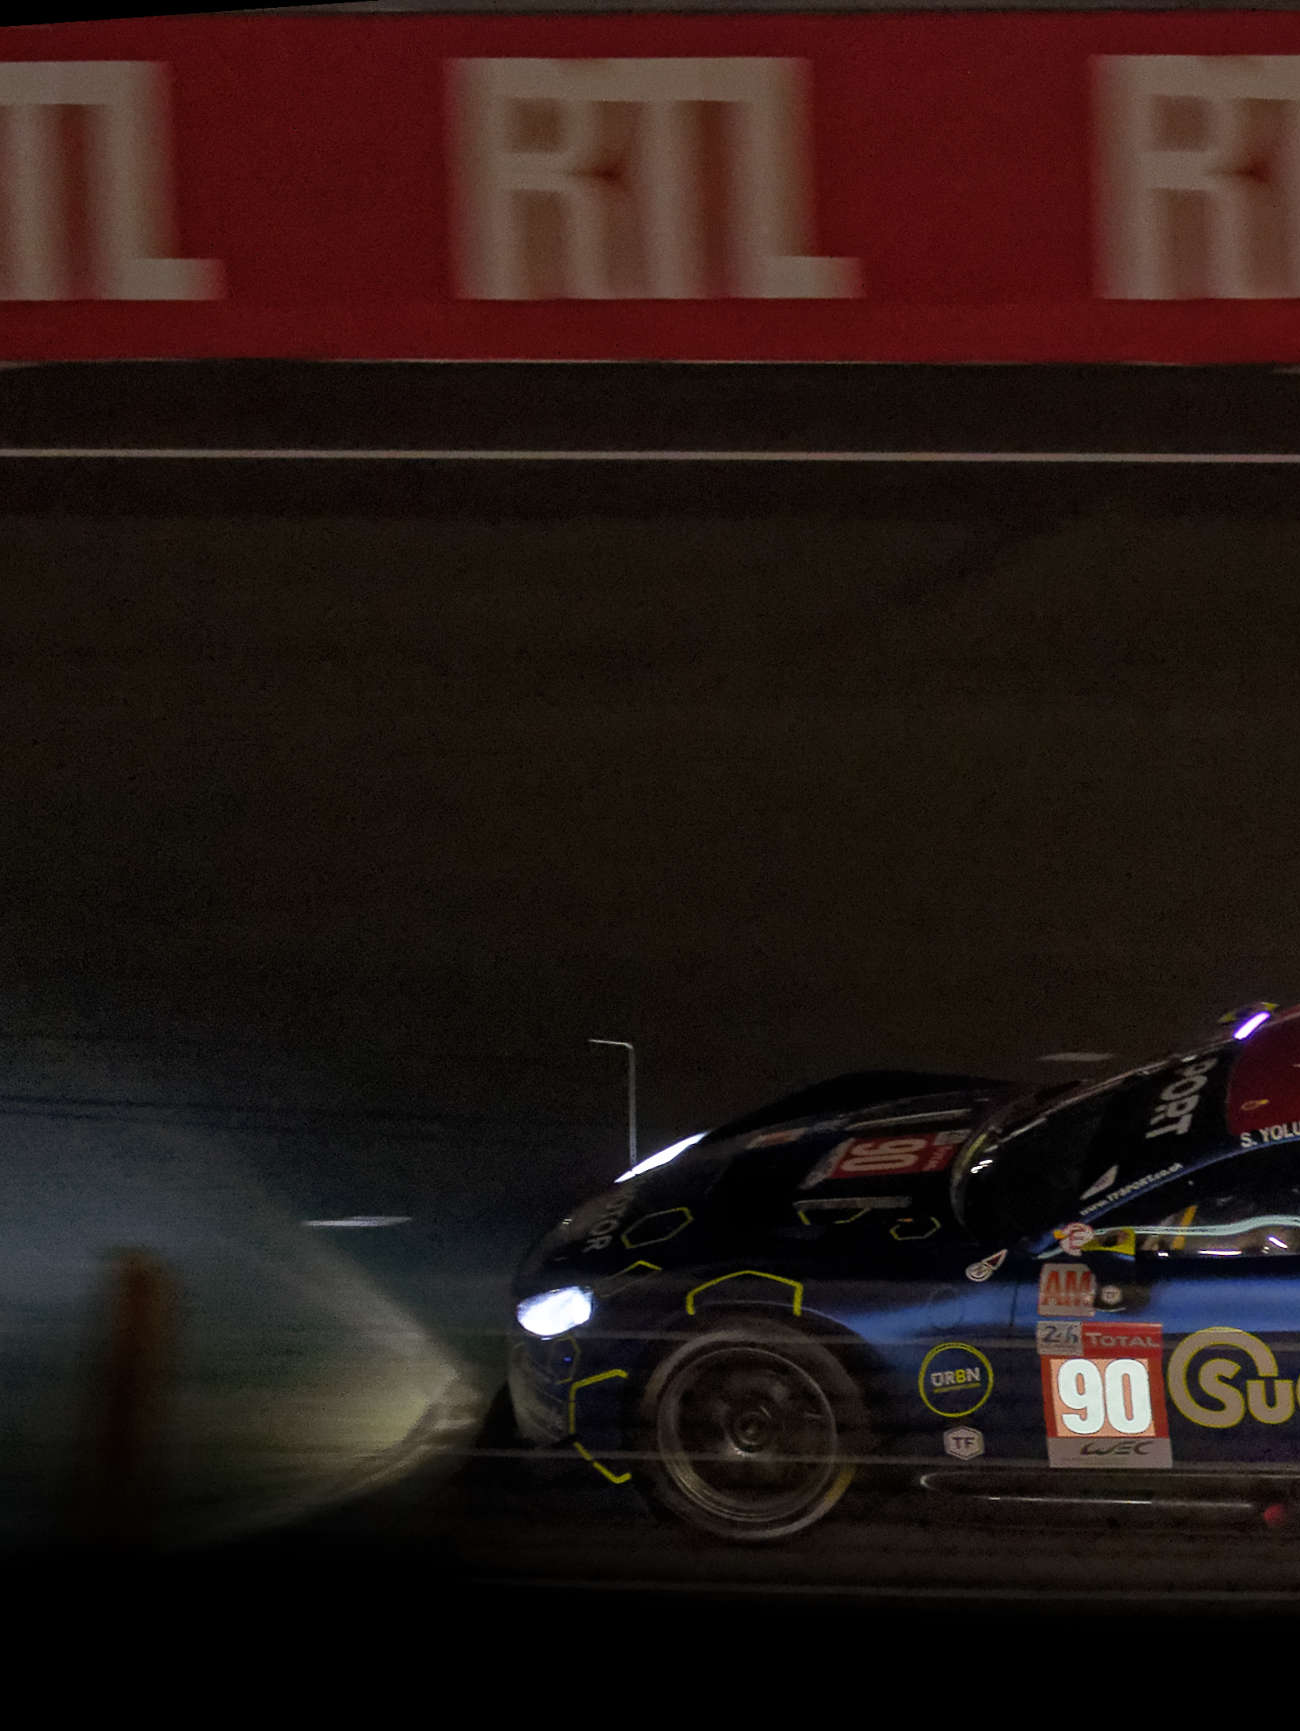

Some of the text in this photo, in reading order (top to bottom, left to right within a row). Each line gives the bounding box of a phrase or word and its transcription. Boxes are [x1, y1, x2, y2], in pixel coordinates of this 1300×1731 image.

[443, 56, 867, 300] RTL
[1085, 1331, 1161, 1348] TOTAL
[1057, 1357, 1153, 1435] 90
[1080, 1440, 1153, 1456] WEC
